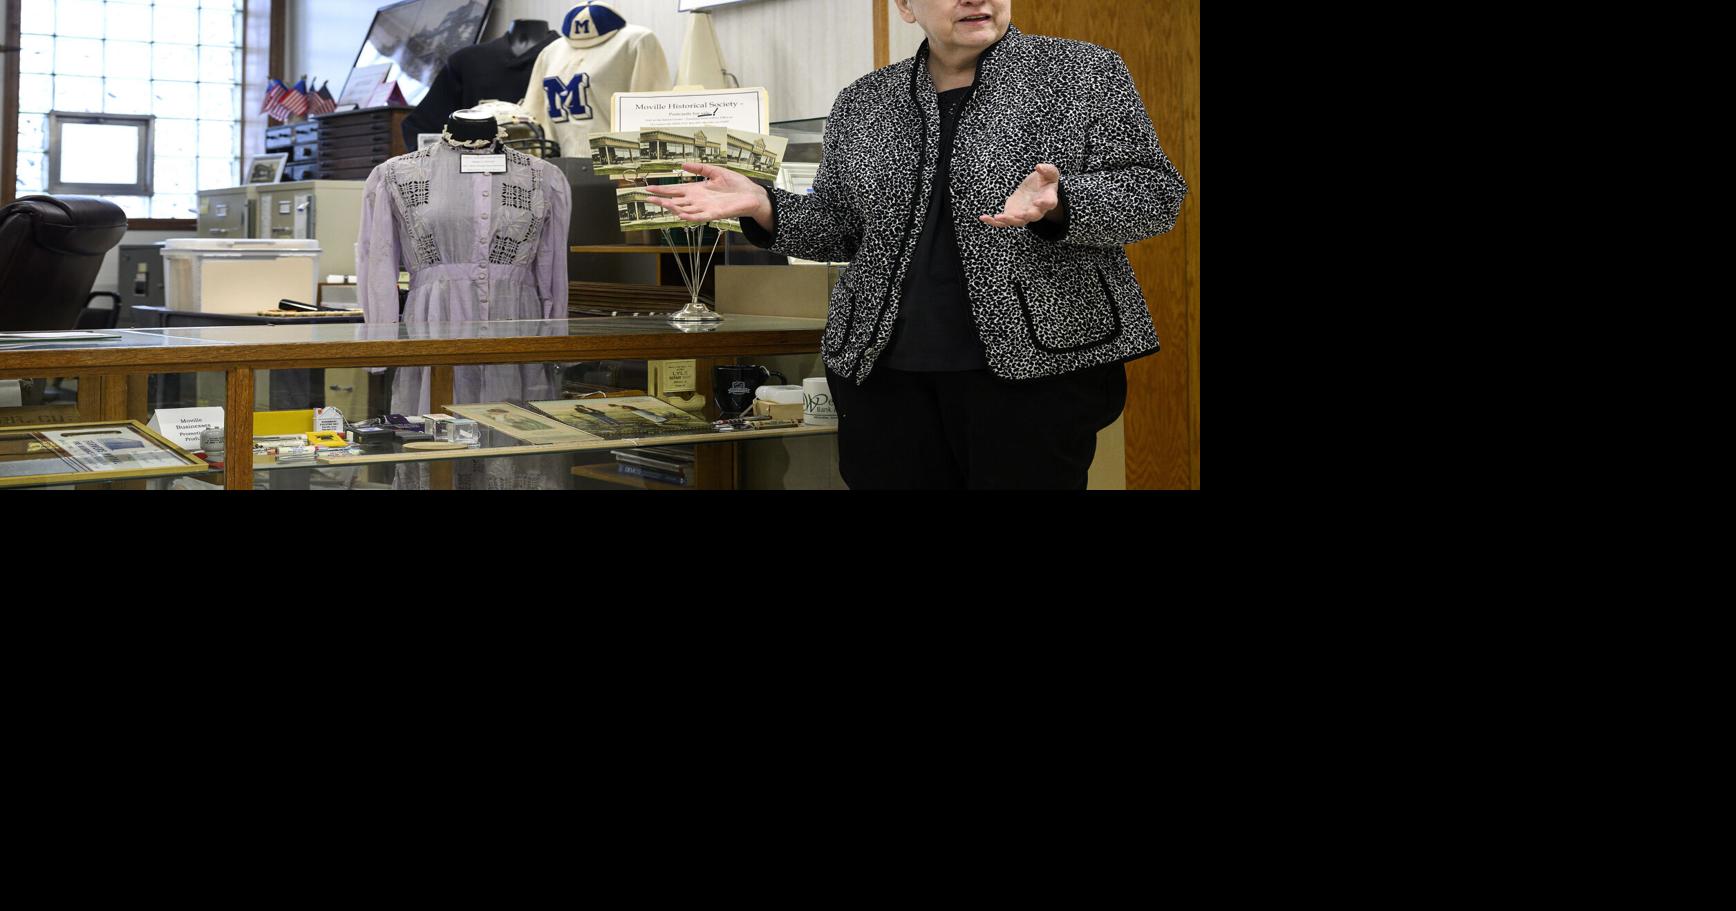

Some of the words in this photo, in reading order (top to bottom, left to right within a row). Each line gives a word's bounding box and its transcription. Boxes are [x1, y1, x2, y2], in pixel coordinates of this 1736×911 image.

[575, 19, 590, 34] M
[543, 72, 593, 123] M
[635, 103, 666, 111] Moville
[669, 102, 707, 110] Historical
[709, 101, 738, 109] Society
